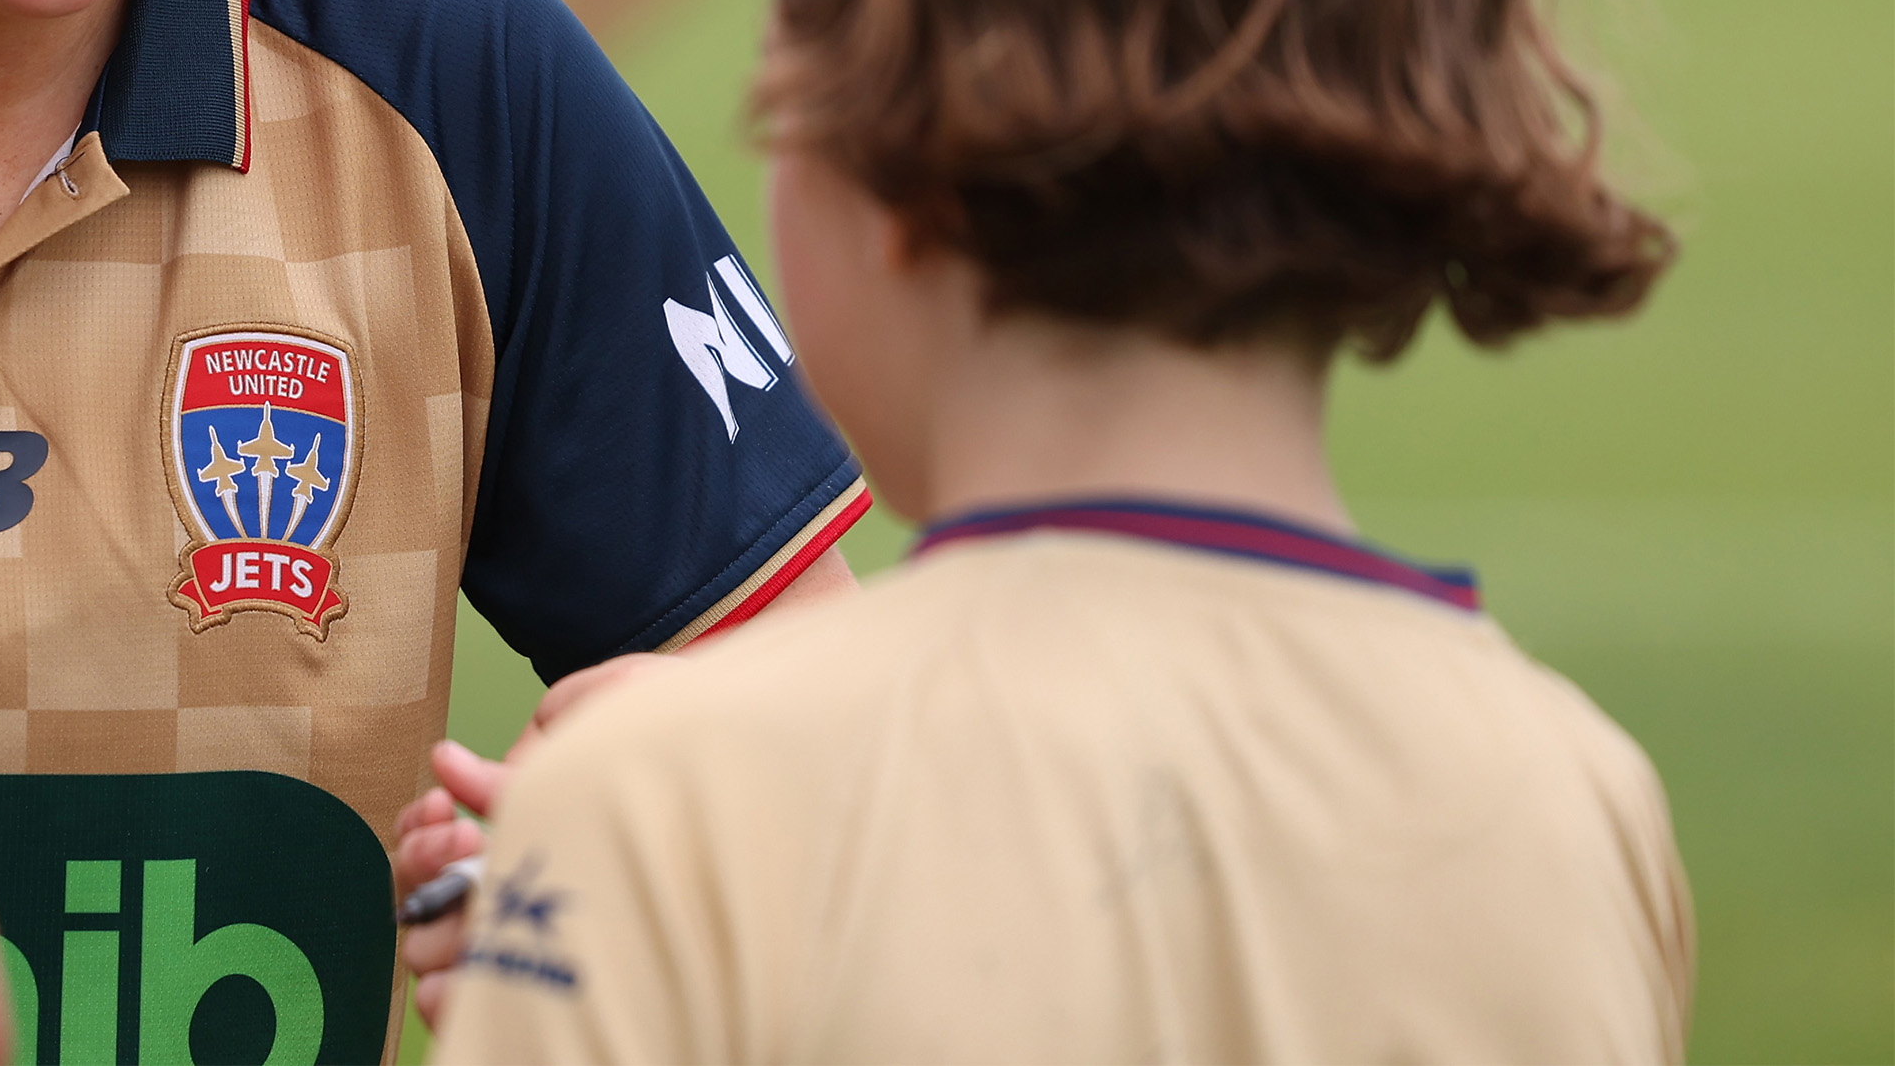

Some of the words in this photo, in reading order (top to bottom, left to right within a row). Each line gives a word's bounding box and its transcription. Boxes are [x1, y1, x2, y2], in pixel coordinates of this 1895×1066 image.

[205, 349, 331, 383] NEWCASTLE
[228, 374, 304, 399] UNITED
[209, 551, 314, 598] JETS
